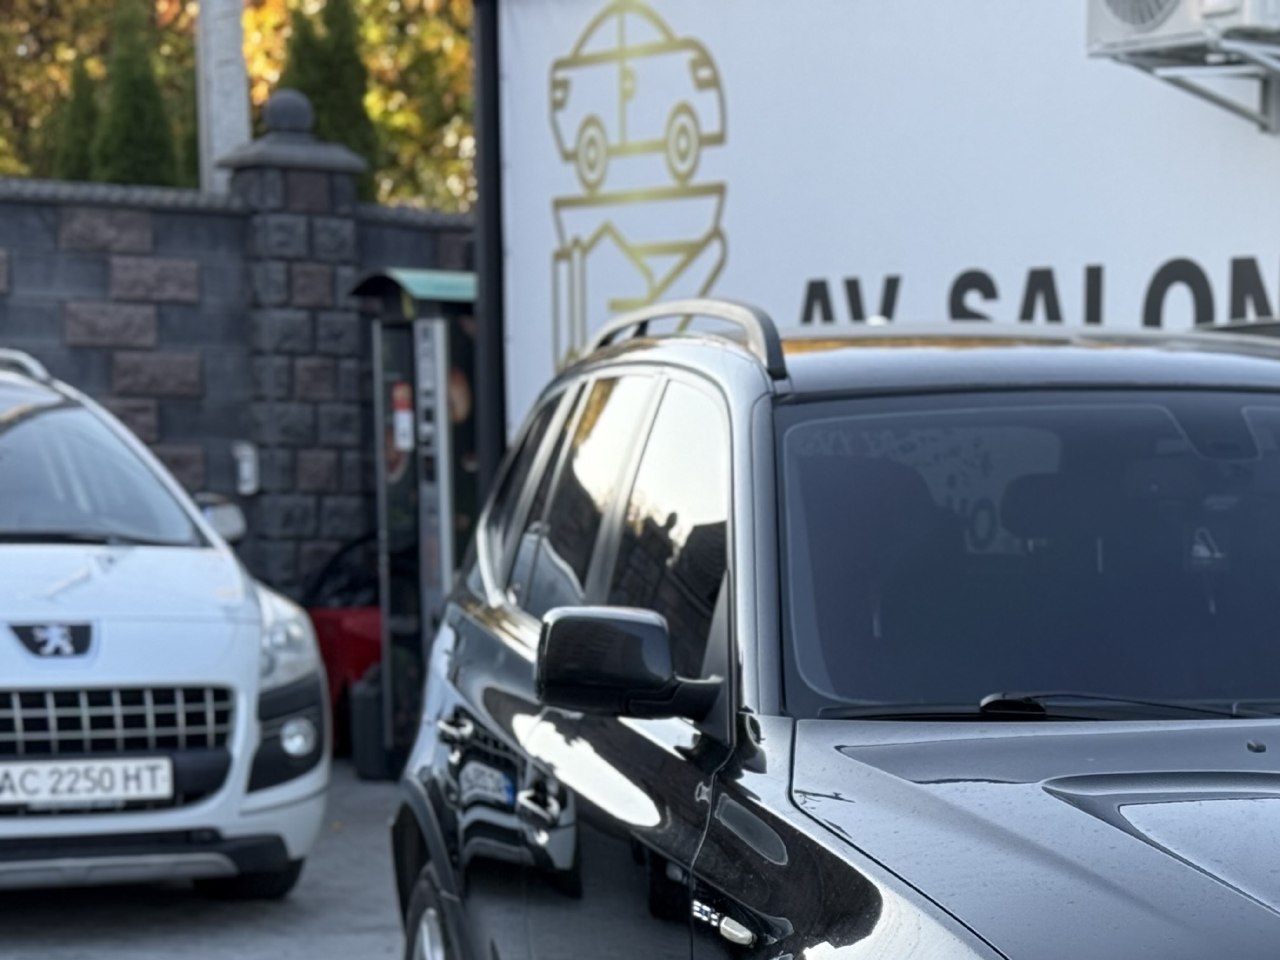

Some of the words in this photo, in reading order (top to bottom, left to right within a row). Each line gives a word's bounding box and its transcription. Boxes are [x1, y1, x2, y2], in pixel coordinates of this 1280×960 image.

[0, 768, 40, 795] AC
[49, 766, 115, 794] 2250
[122, 764, 162, 792] HT
